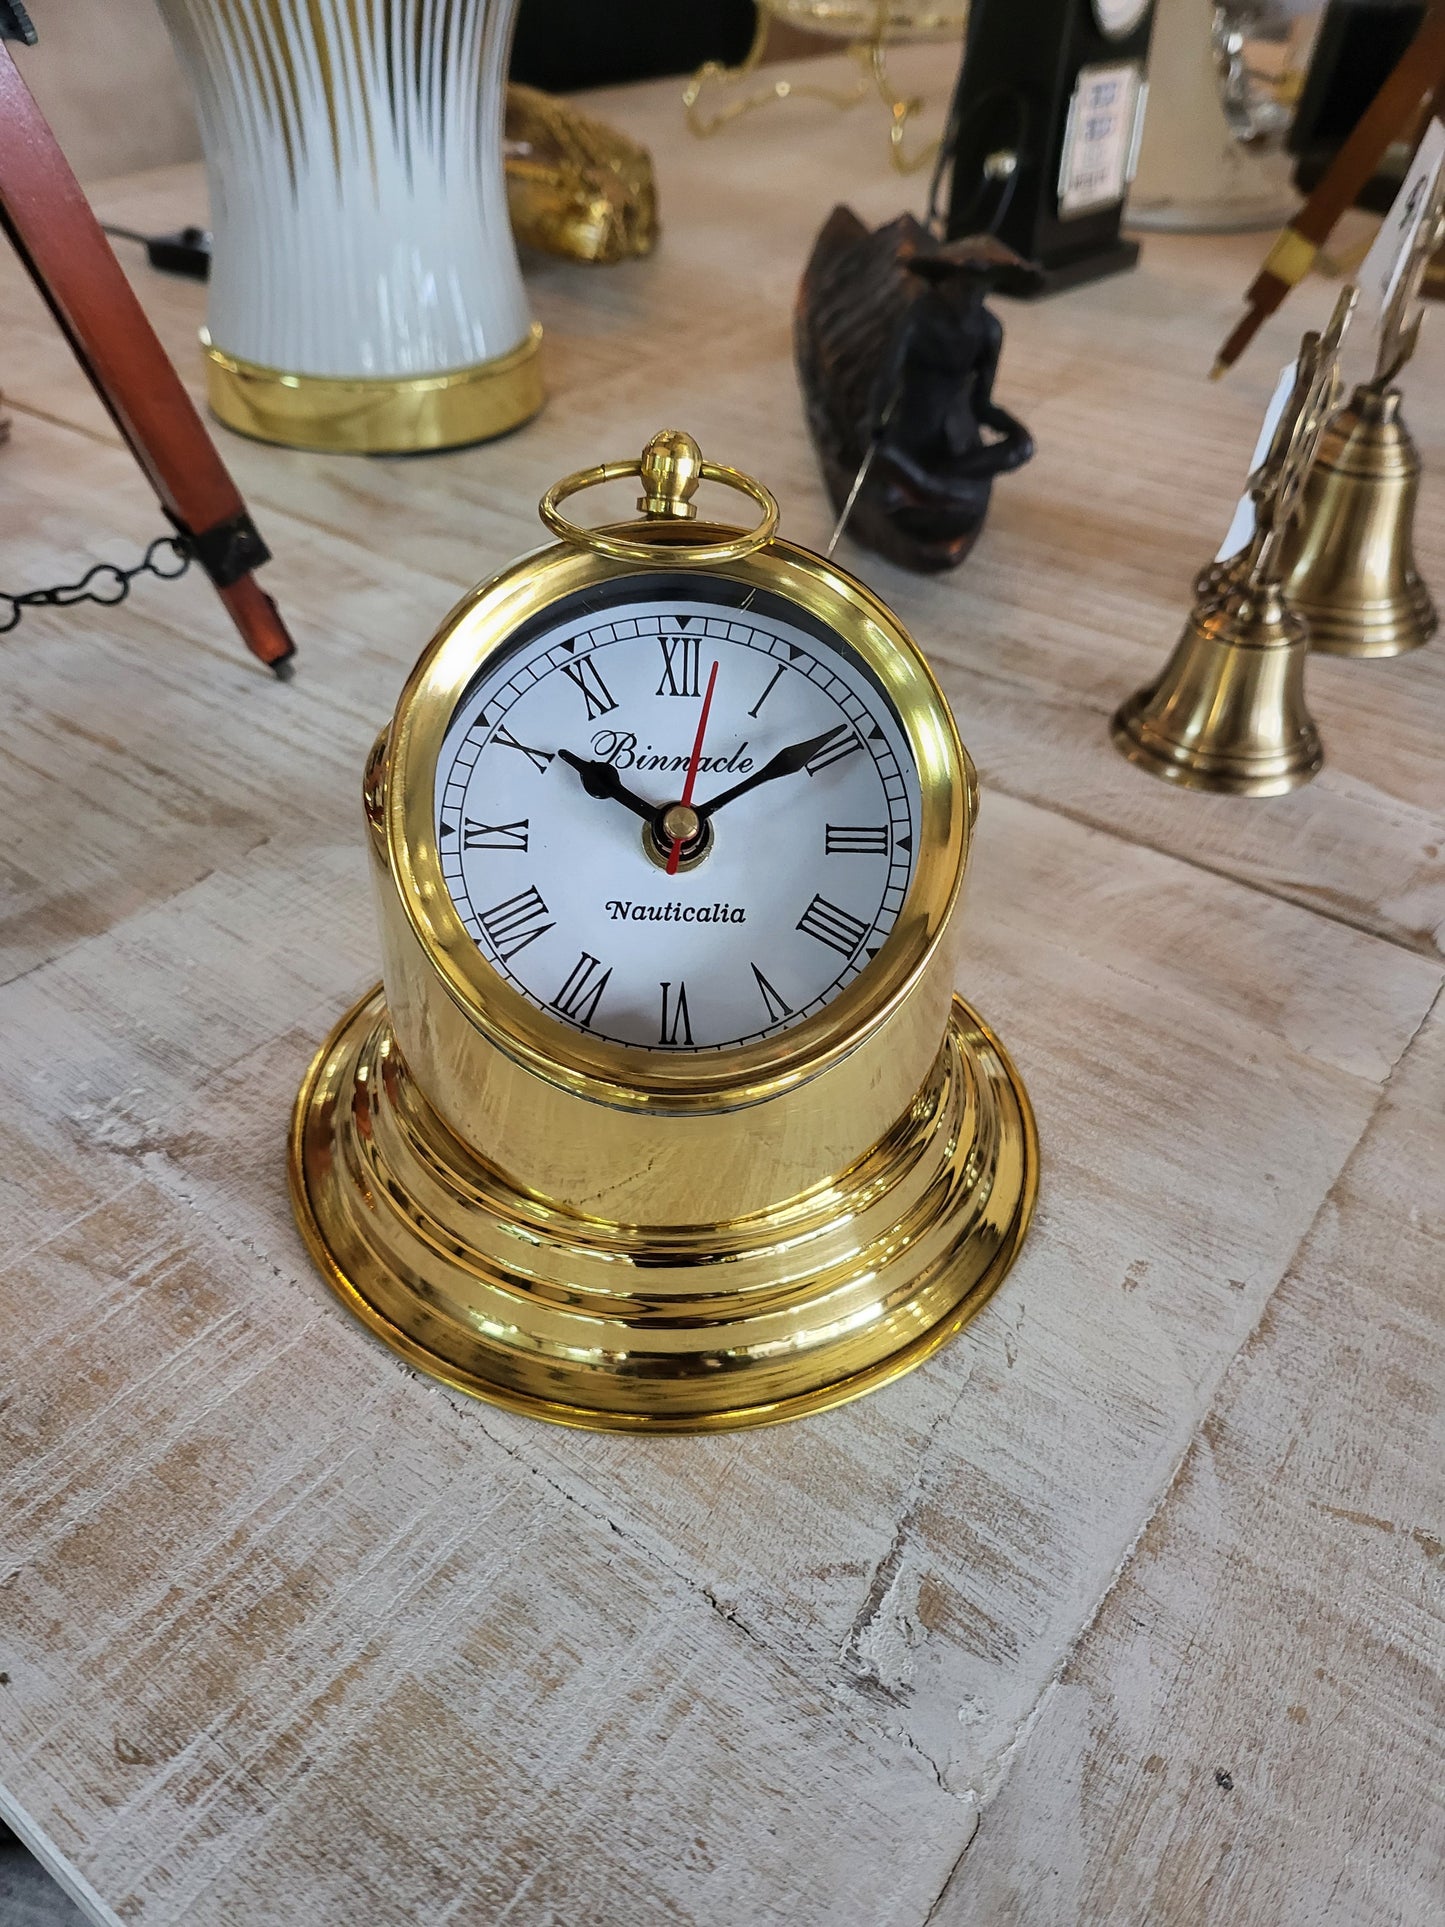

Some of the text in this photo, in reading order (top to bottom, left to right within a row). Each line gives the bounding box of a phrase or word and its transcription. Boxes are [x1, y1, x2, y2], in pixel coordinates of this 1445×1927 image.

[560, 655, 619, 721] XI
[655, 637, 702, 697] XII
[747, 663, 788, 719] I
[490, 724, 555, 774] X
[591, 730, 754, 774] Binnacle
[805, 731, 864, 777] II
[464, 817, 529, 853] IX
[825, 823, 889, 856] III
[478, 885, 556, 963] VIII
[605, 901, 746, 923] Nauticalia
[796, 893, 871, 960] IIII
[549, 951, 613, 1027] VII
[658, 981, 694, 1046] VI
[750, 961, 793, 1023] V
